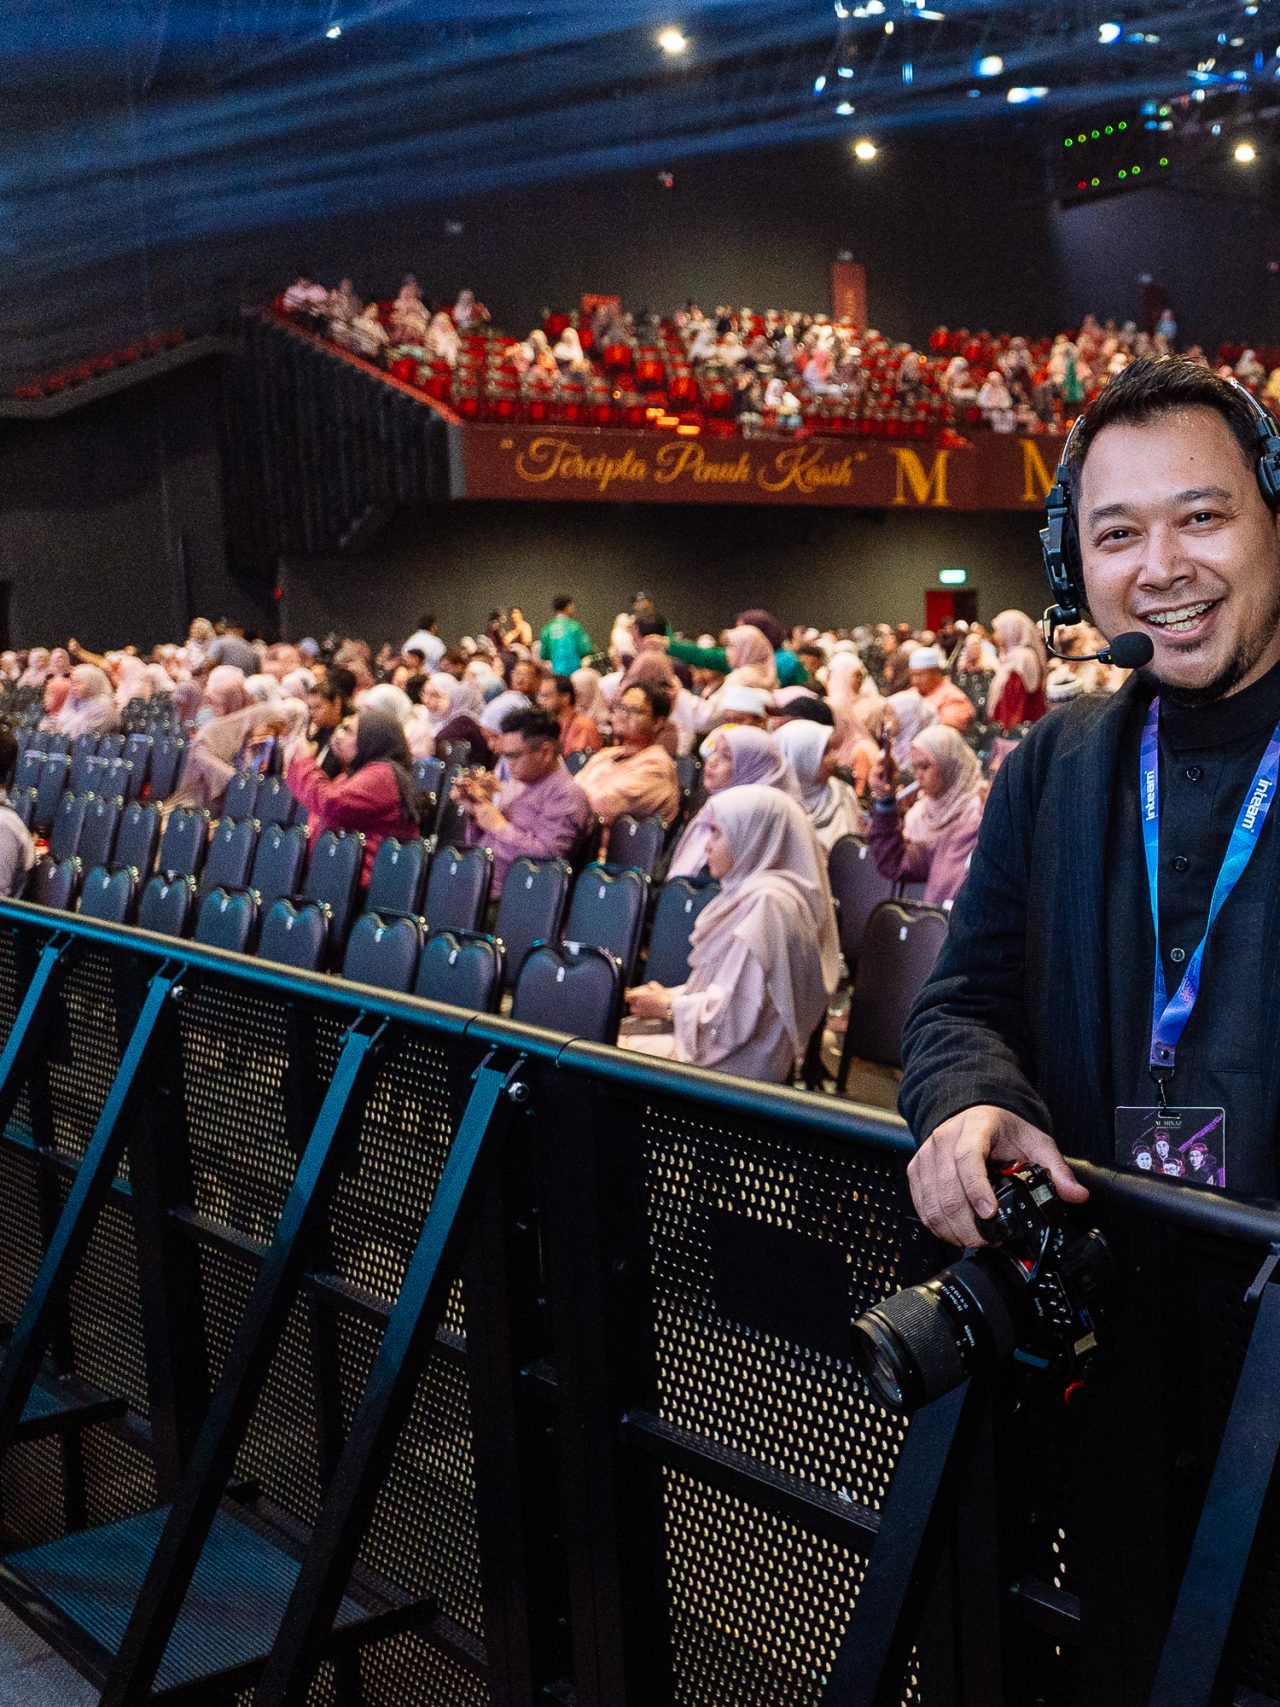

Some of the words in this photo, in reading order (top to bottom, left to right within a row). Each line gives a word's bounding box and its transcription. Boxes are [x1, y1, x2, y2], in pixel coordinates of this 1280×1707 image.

[654, 441, 748, 484] Penuh
[889, 447, 950, 507] M
[1241, 778, 1273, 830] inteam
